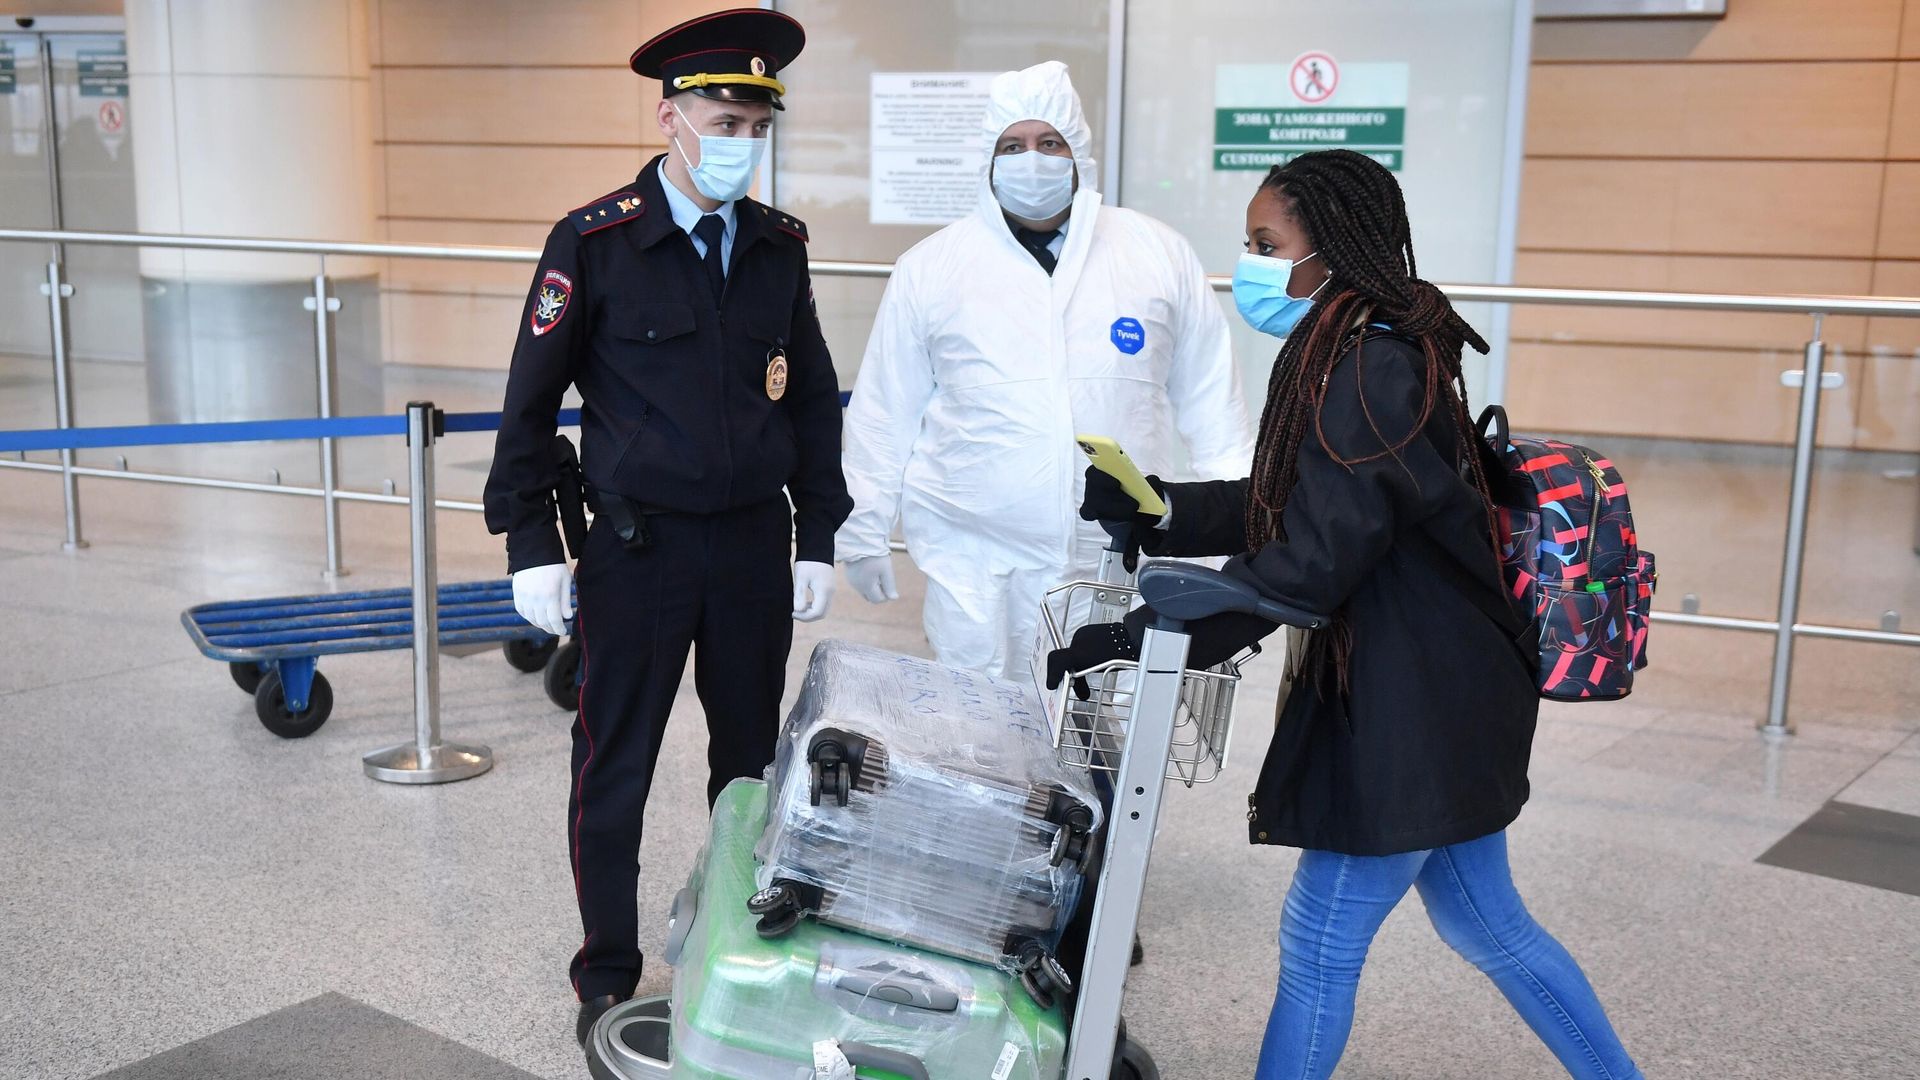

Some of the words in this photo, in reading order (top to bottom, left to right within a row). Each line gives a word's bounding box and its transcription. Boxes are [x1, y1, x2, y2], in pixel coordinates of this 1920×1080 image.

[1233, 112, 1271, 126] ЗОНА
[1273, 111, 1387, 126] ТАМОЖЕННОГО
[1269, 128, 1347, 142] КОНТРОЛЯ
[1220, 152, 1285, 165] CUSTOMS
[1116, 329, 1140, 341] Tyvek
[816, 1065, 829, 1073] DME
